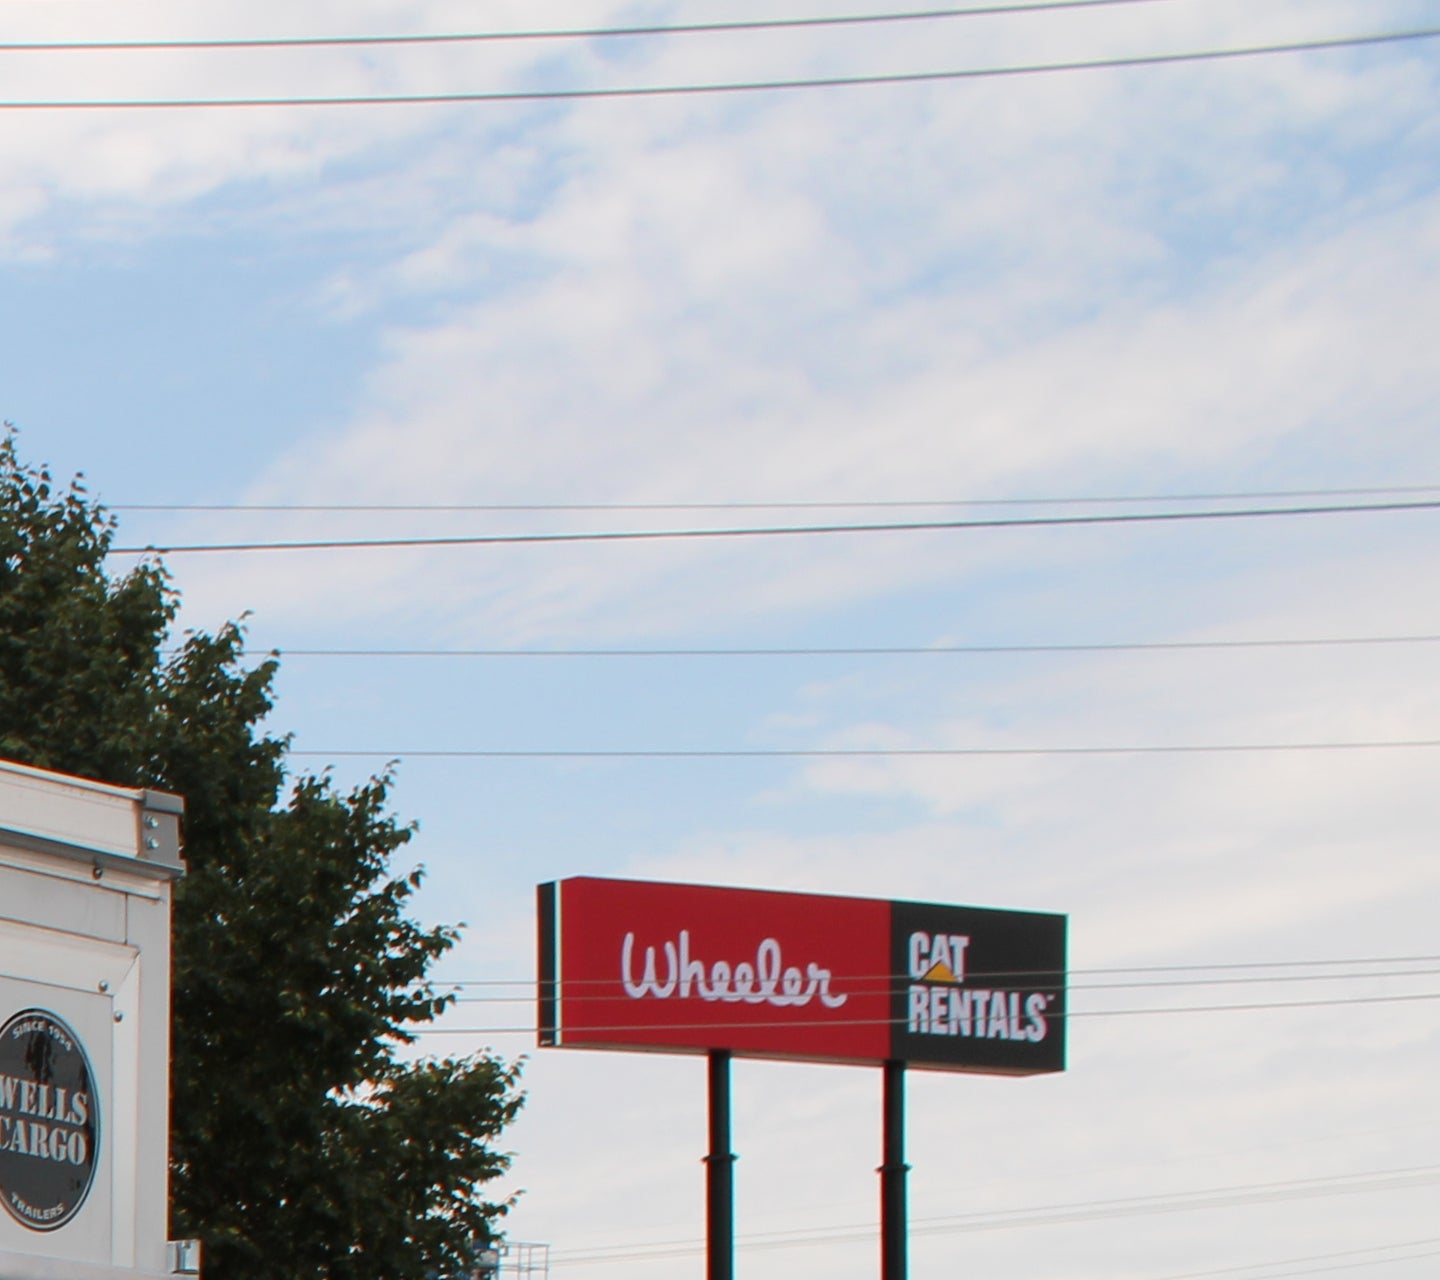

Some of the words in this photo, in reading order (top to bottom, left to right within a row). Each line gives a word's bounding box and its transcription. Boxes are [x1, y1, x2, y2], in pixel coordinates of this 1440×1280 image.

[621, 930, 847, 1008] Wheeler
[908, 931, 970, 984] CAT
[12, 1020, 46, 1040] SINCE
[908, 984, 1047, 1043] RENTALS
[11, 1191, 65, 1221] TRAILERS
